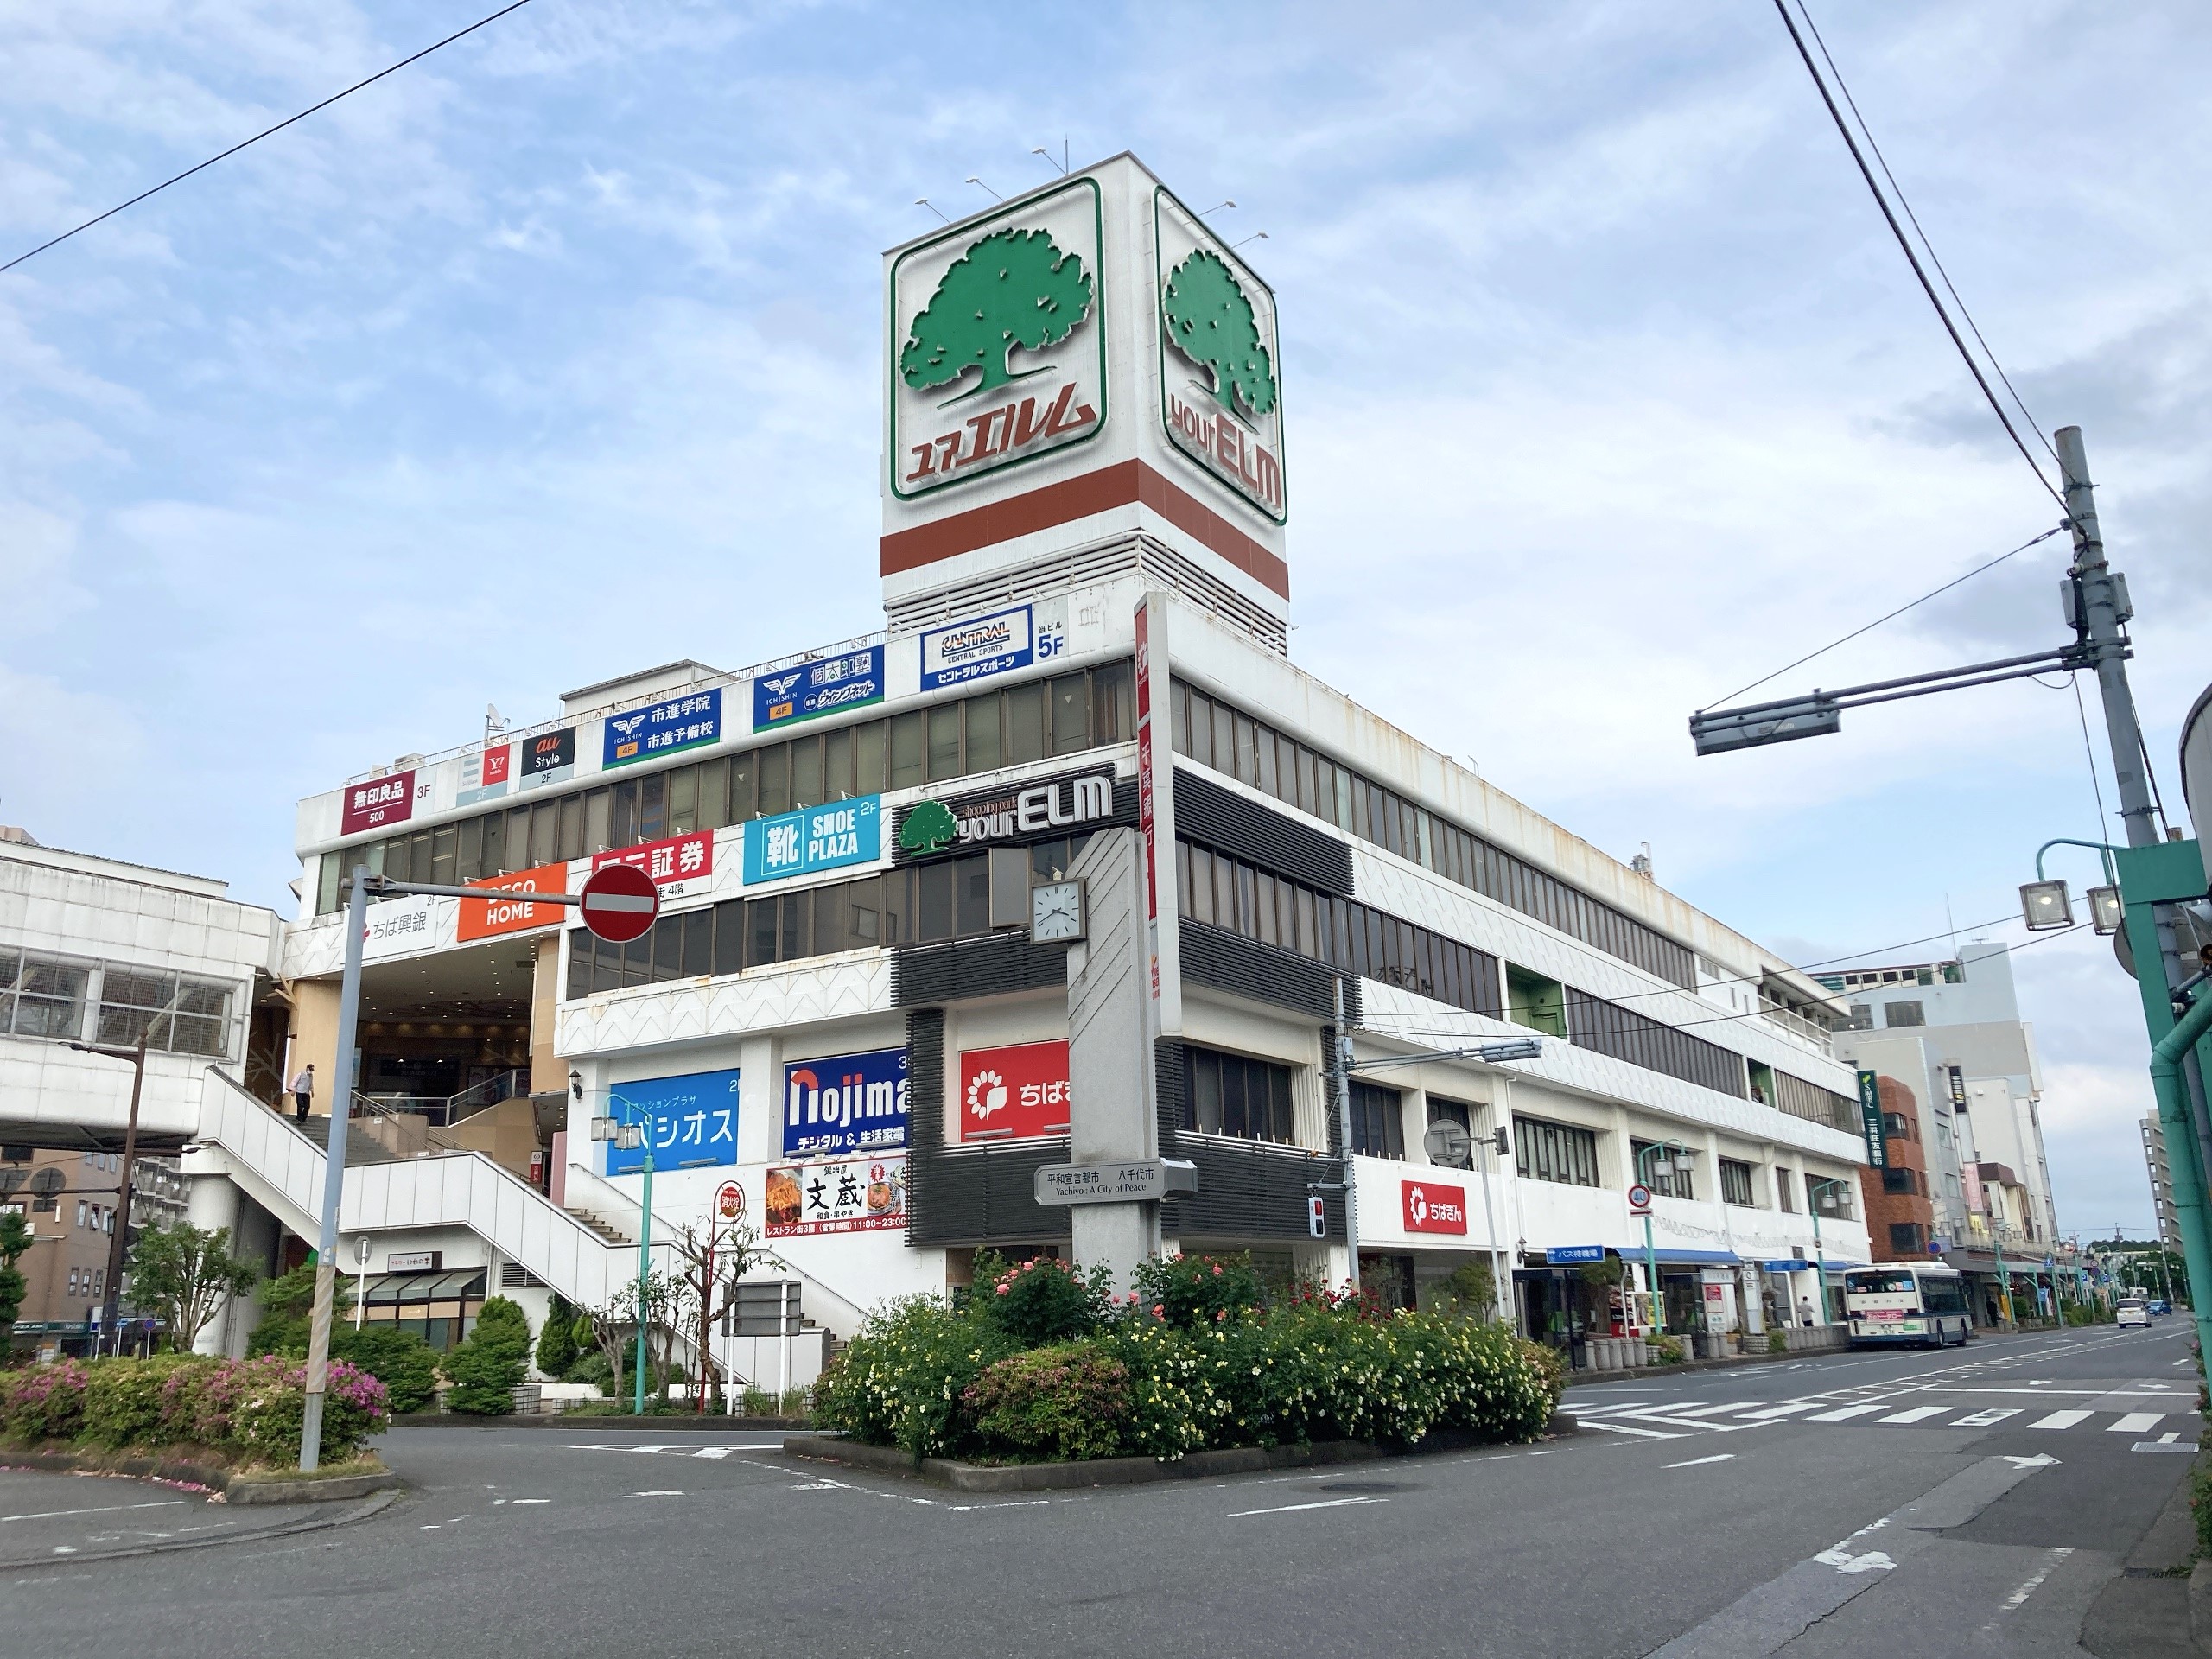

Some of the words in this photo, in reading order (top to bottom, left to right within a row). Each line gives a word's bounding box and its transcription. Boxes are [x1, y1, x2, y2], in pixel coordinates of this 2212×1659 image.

[906, 381, 1097, 483] ユアエルム
[1039, 621, 1063, 634] 当ビル
[948, 649, 976, 664] CENTRAL
[979, 644, 1003, 656] SPORTS
[1038, 633, 1064, 658] 5F
[938, 655, 1015, 684] セントラルスポーツ
[766, 692, 798, 705] ICHISHIN
[652, 695, 711, 723] 市進学院
[775, 706, 787, 715] 4F
[536, 736, 561, 753] au
[614, 732, 642, 745] ICHISHIN
[647, 721, 714, 749] 市進予備校
[621, 746, 632, 755] 4F
[535, 753, 560, 768] Style
[541, 772, 552, 784] 2F
[353, 780, 404, 809] 無印良品
[417, 785, 431, 798] 3F
[476, 788, 487, 801] 2F
[369, 810, 385, 823] 500
[861, 801, 877, 817] 2F
[812, 808, 855, 838] SHOE
[767, 824, 799, 868] 靴
[808, 831, 858, 863] PLAZA
[668, 882, 684, 895] 4階
[486, 901, 534, 926] HOME
[373, 911, 427, 939] ちば興銀
[798, 1134, 842, 1150] デジタル
[846, 1133, 856, 1147] &
[860, 1126, 905, 1143] 生活家電
[1047, 1171, 1100, 1186] 平和宣言都市
[1118, 1167, 1154, 1182] 八千代市
[807, 1173, 866, 1211] 文蔵
[1056, 1185, 1084, 1197] Yachiyo
[1097, 1185, 1112, 1195] City
[1115, 1183, 1123, 1192] of
[1125, 1183, 1147, 1192] Peace
[721, 1196, 740, 1210] 消火栓
[1430, 1203, 1462, 1222] ちばぎん
